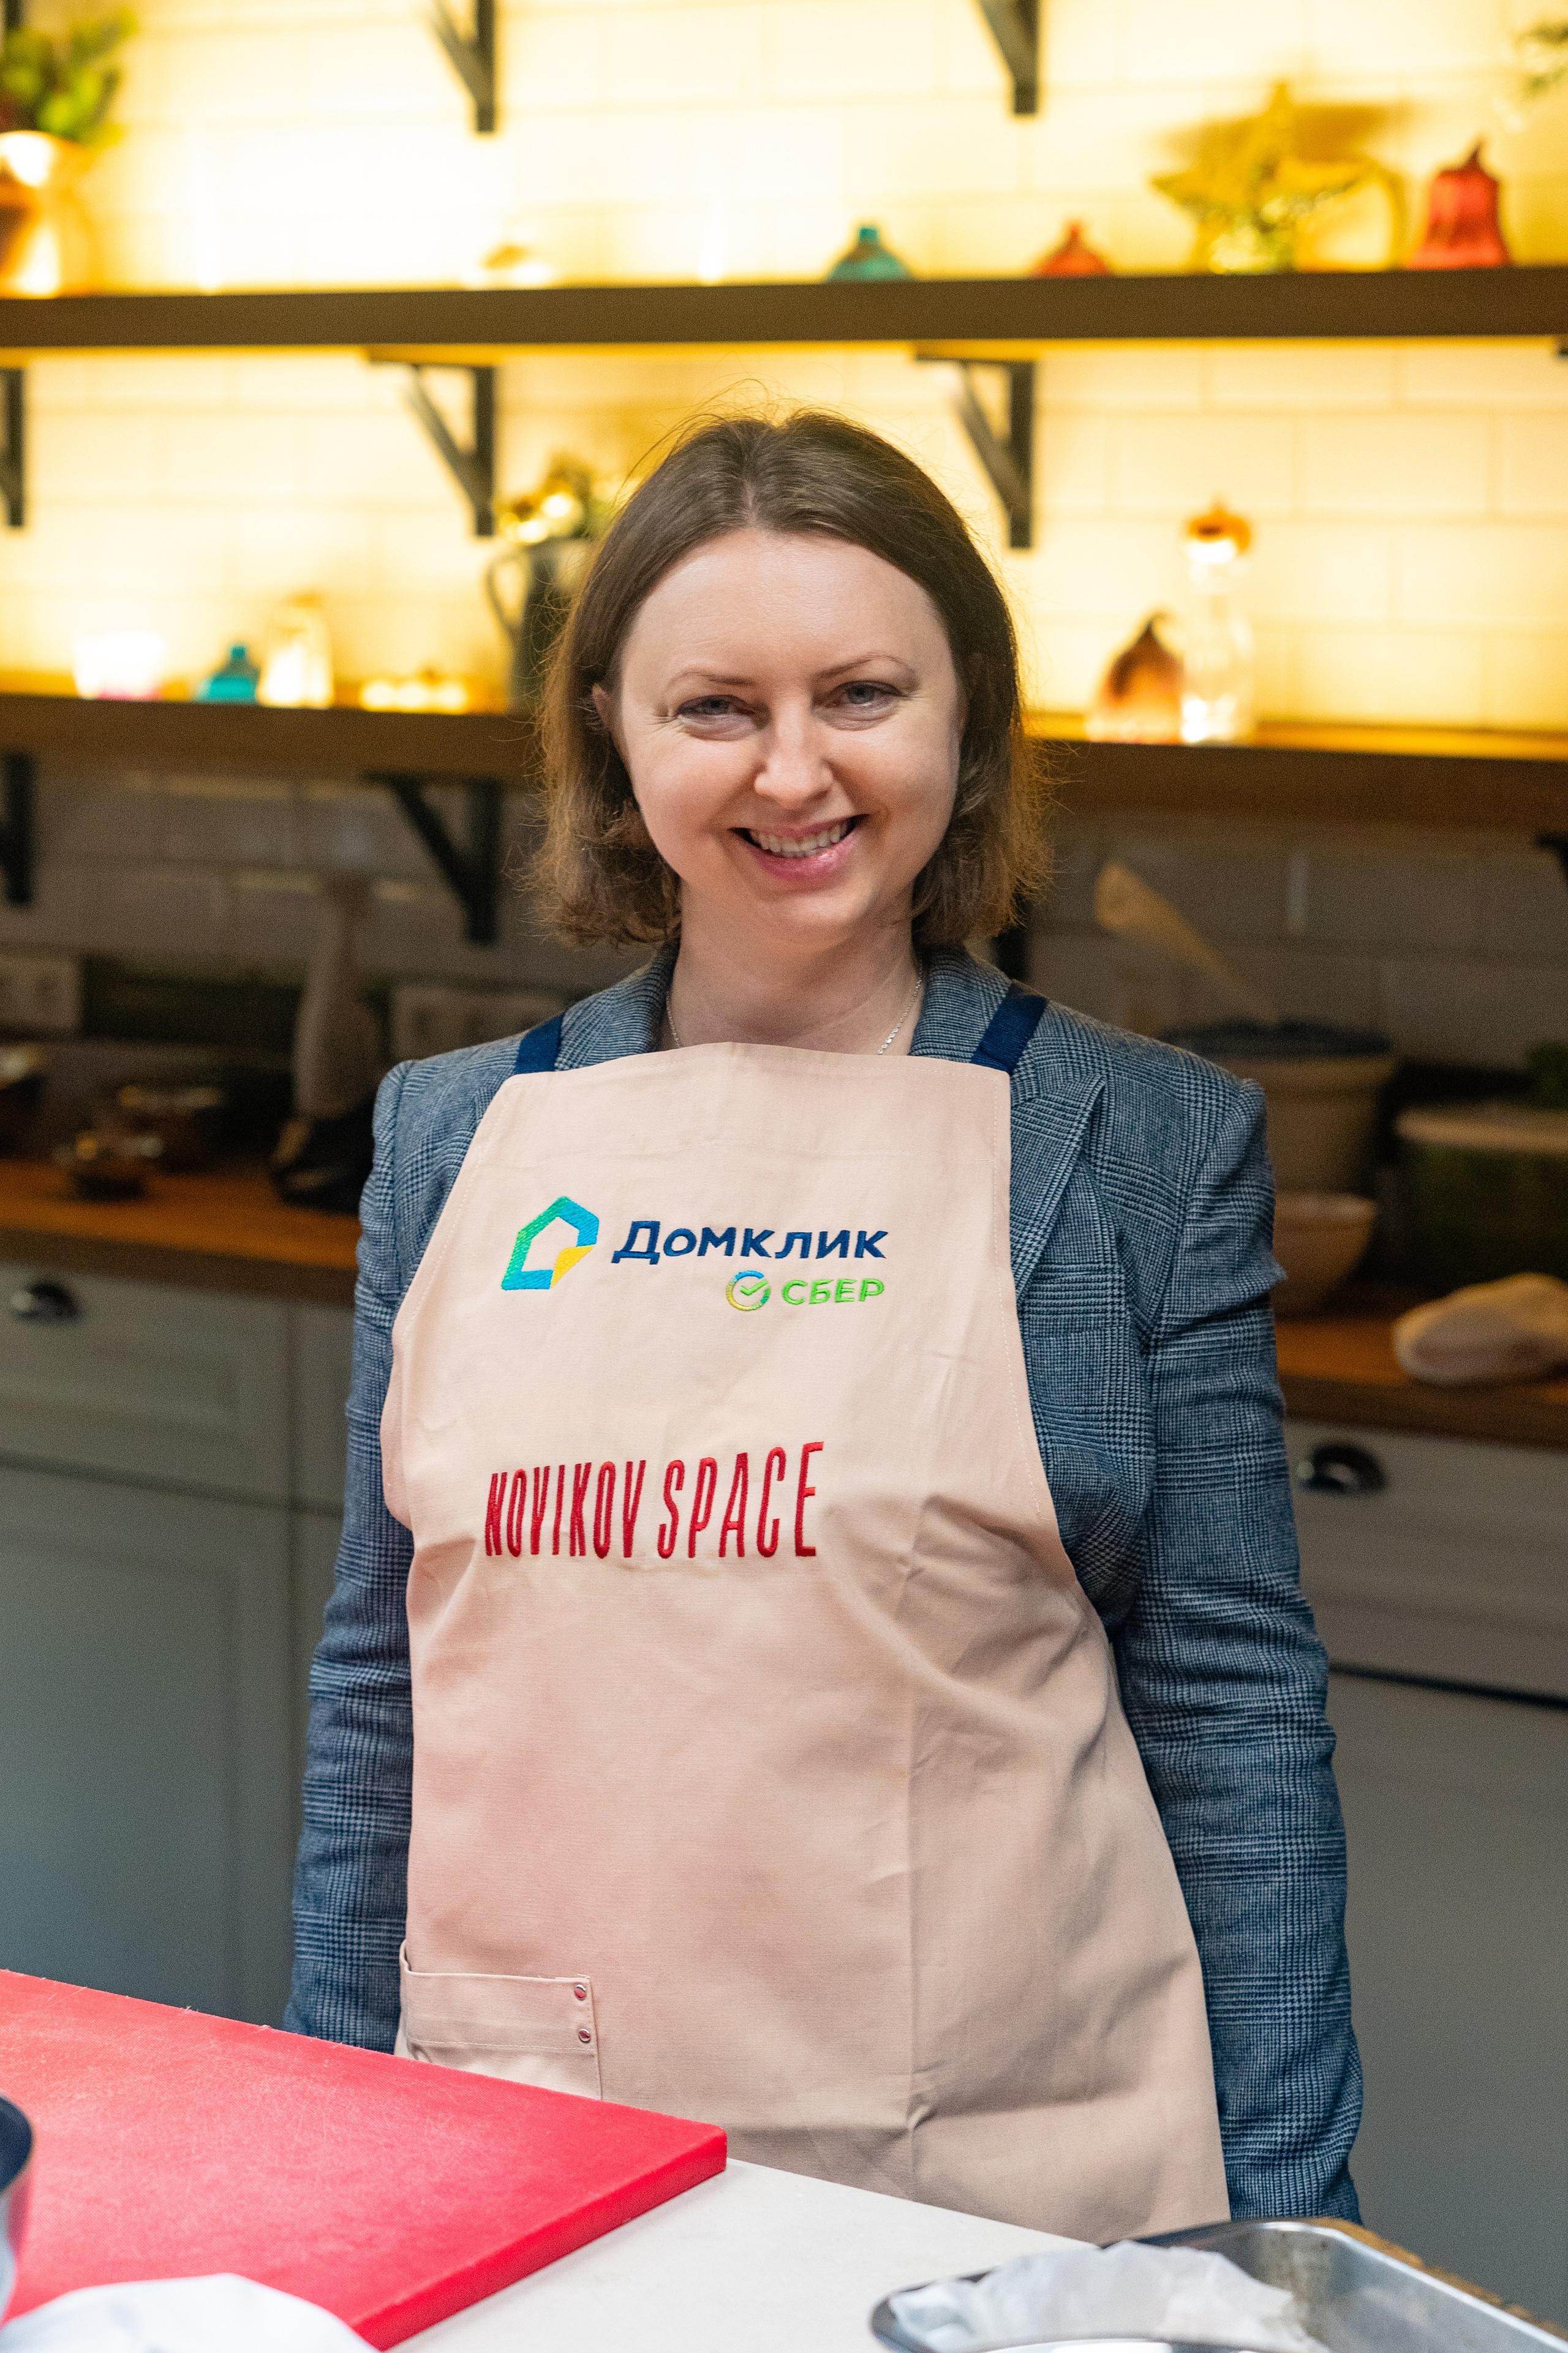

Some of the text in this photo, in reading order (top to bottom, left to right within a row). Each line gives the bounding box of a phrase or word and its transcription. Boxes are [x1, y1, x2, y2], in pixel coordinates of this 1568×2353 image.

[611, 1220, 888, 1265] Домклик
[782, 1278, 885, 1306] СБЕР
[484, 1441, 824, 1558] NOVIKOV SPACE
